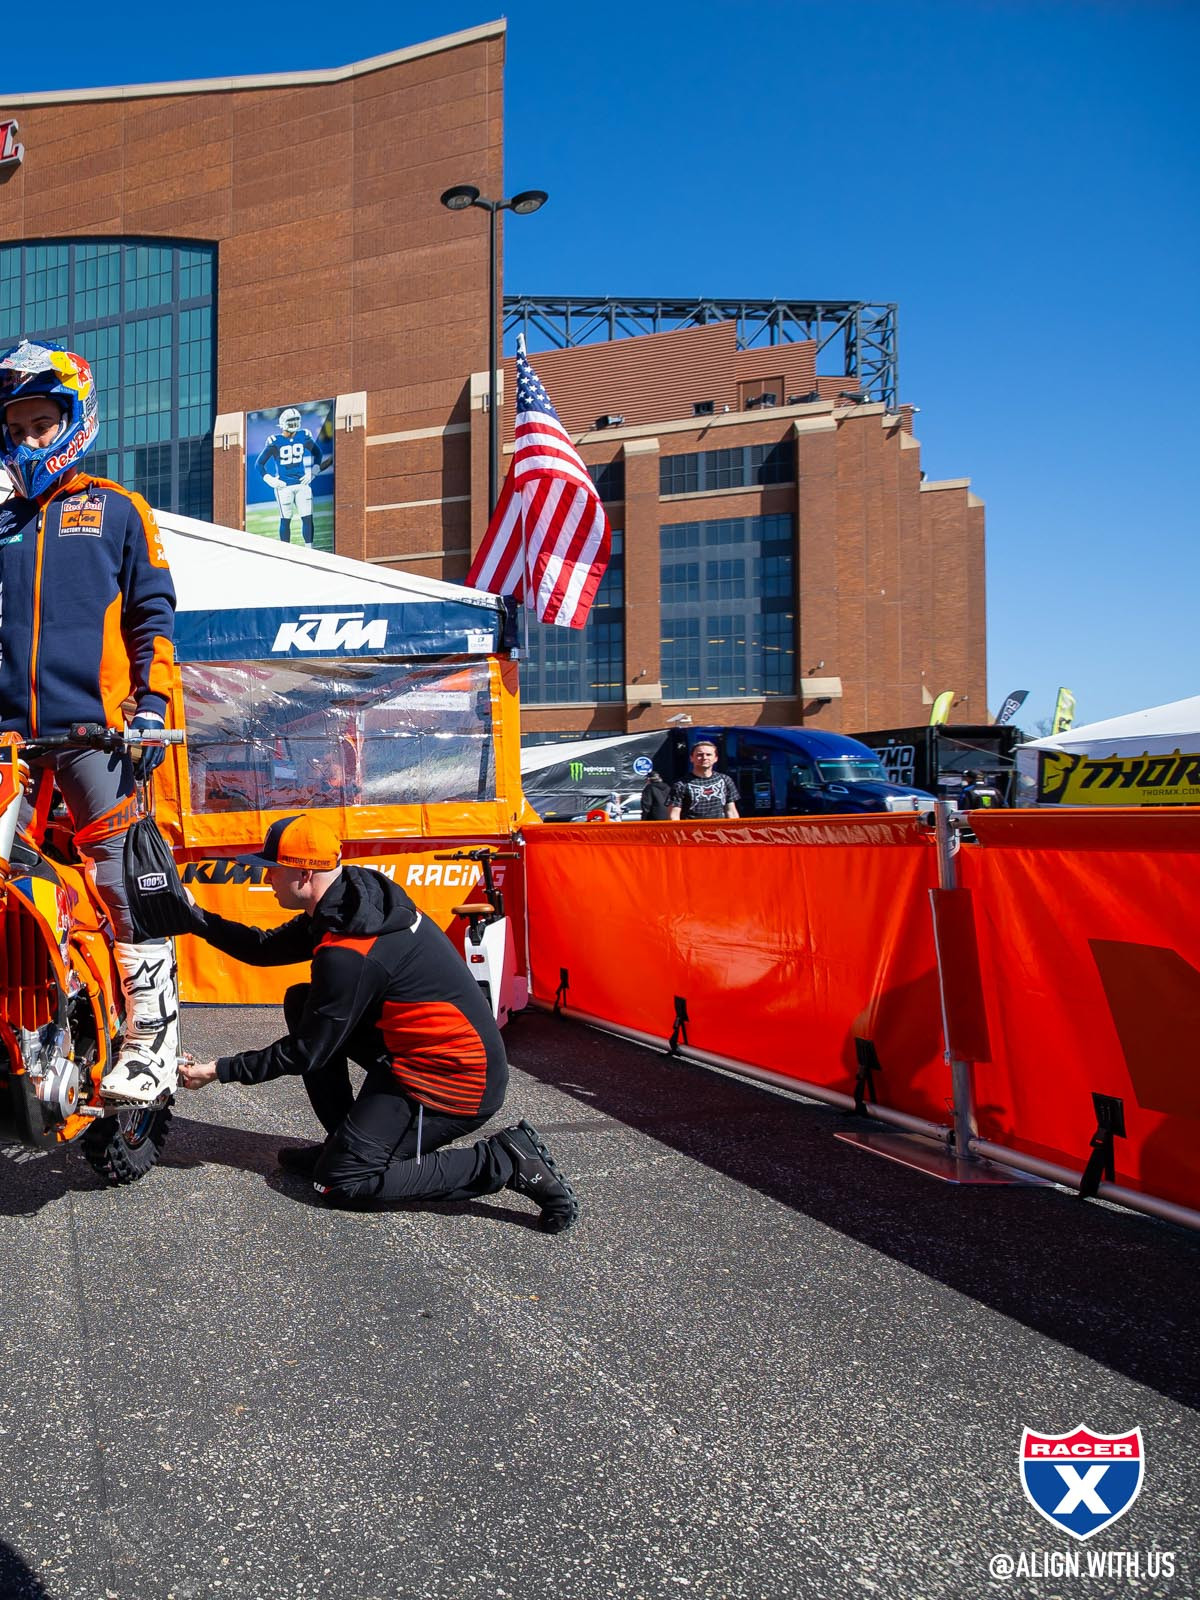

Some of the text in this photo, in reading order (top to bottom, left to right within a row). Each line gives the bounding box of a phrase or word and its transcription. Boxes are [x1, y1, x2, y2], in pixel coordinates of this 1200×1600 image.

[45, 441, 77, 475] Red
[280, 443, 304, 466] 99
[272, 612, 389, 651] KTM
[1079, 755, 1200, 789] THOR
[142, 875, 163, 887] 100%
[181, 857, 264, 885] KTM
